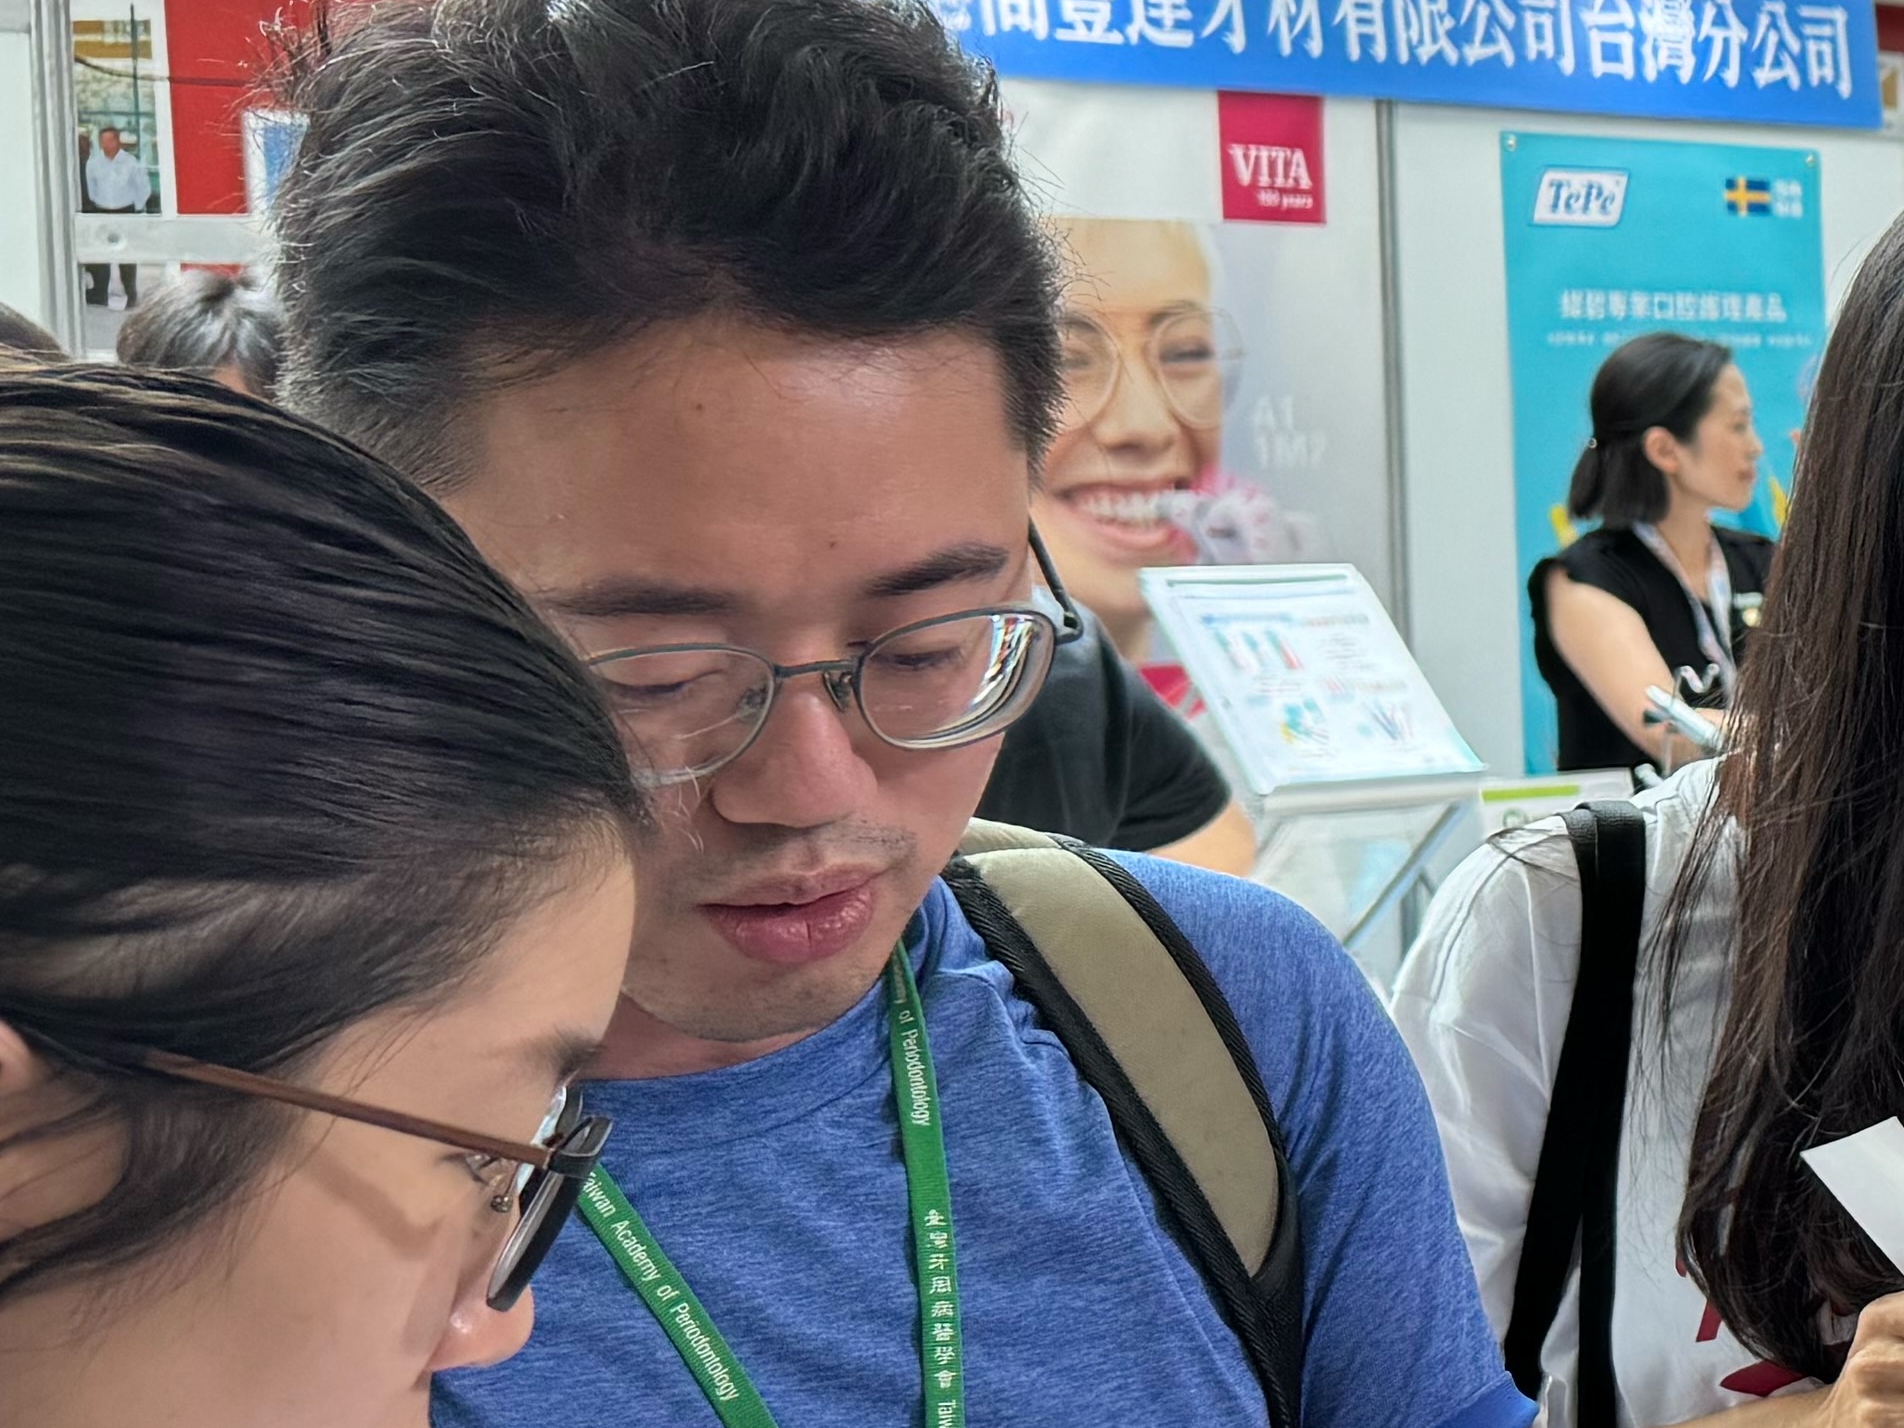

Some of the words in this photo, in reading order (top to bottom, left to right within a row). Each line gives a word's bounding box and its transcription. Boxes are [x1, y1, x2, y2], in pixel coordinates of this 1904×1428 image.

[1228, 144, 1313, 189] VITA
[1548, 178, 1617, 217] TePe
[611, 1219, 661, 1283] Academy
[657, 1283, 679, 1303] of
[670, 1302, 742, 1403] Periodontology
